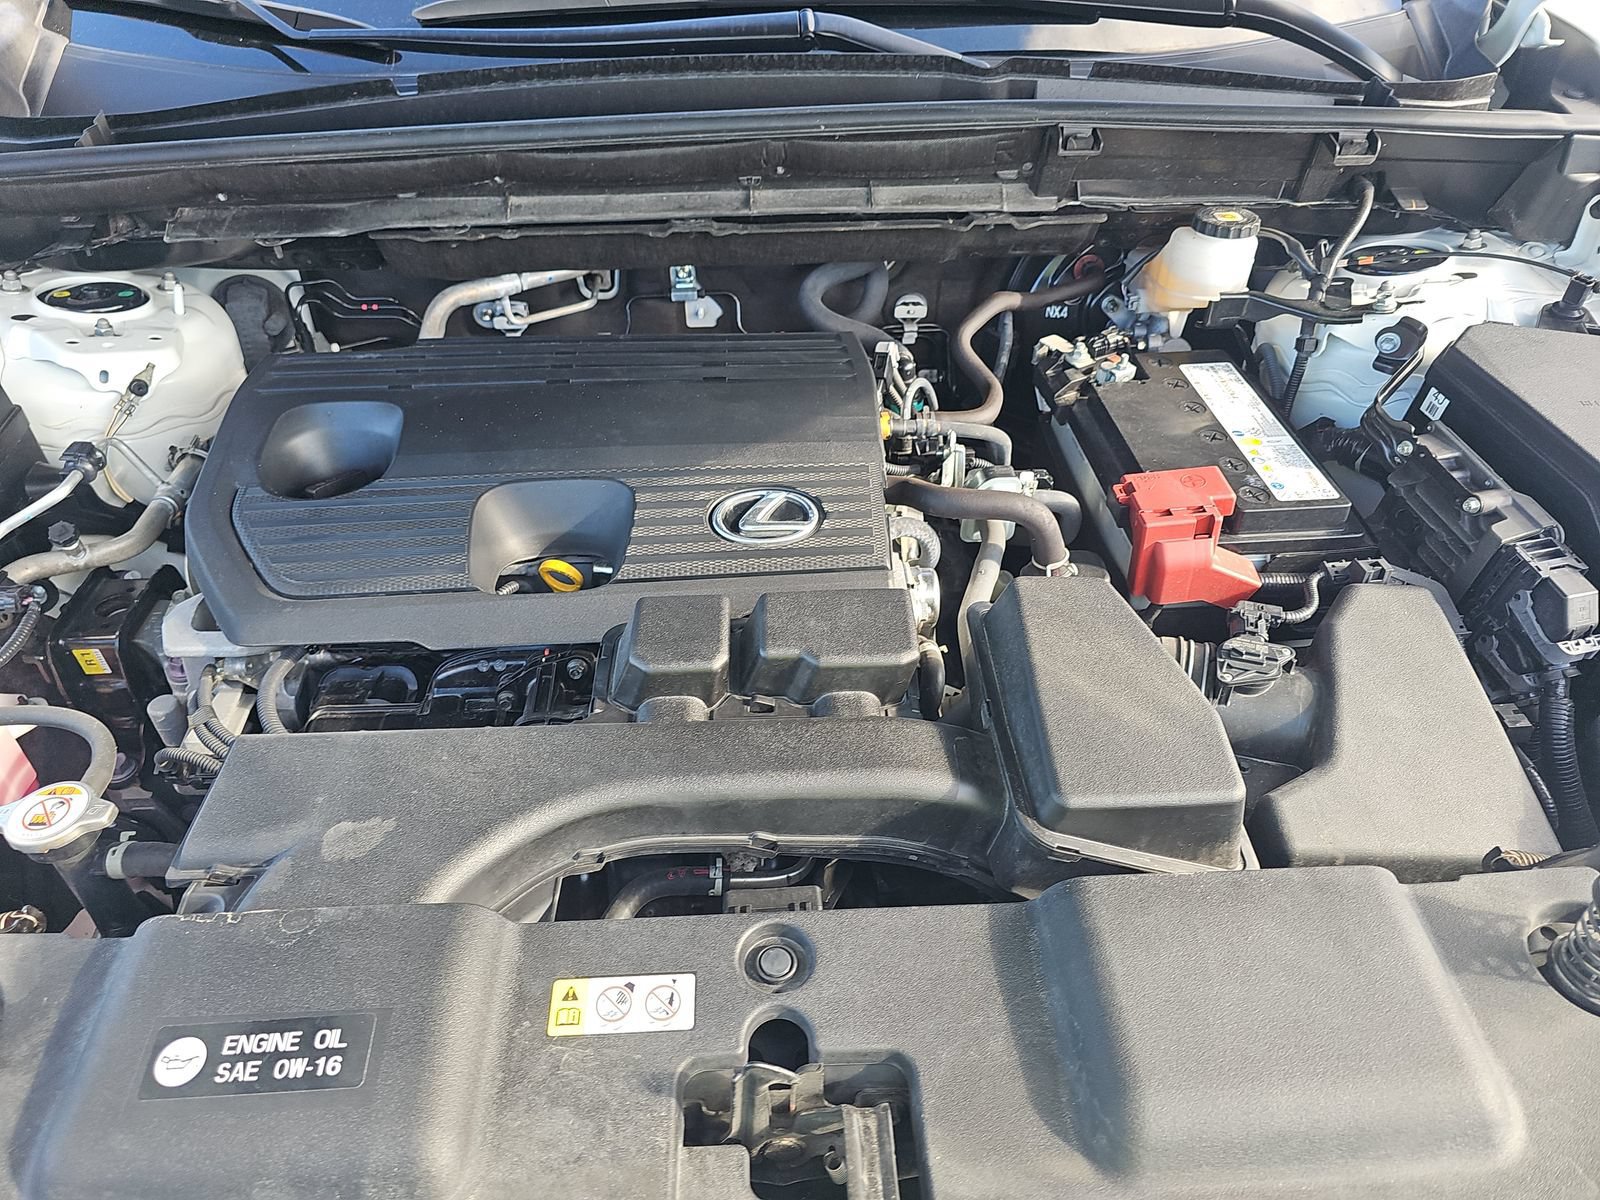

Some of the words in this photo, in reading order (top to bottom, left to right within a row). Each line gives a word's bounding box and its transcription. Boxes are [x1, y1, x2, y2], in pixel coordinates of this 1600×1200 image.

[1045, 304, 1069, 319] NX4
[1432, 391, 1446, 405] 4J
[221, 1030, 303, 1056] ENGINE
[313, 1028, 348, 1050] OIL
[213, 1060, 262, 1083] SAE
[273, 1055, 343, 1080] 0W-16
